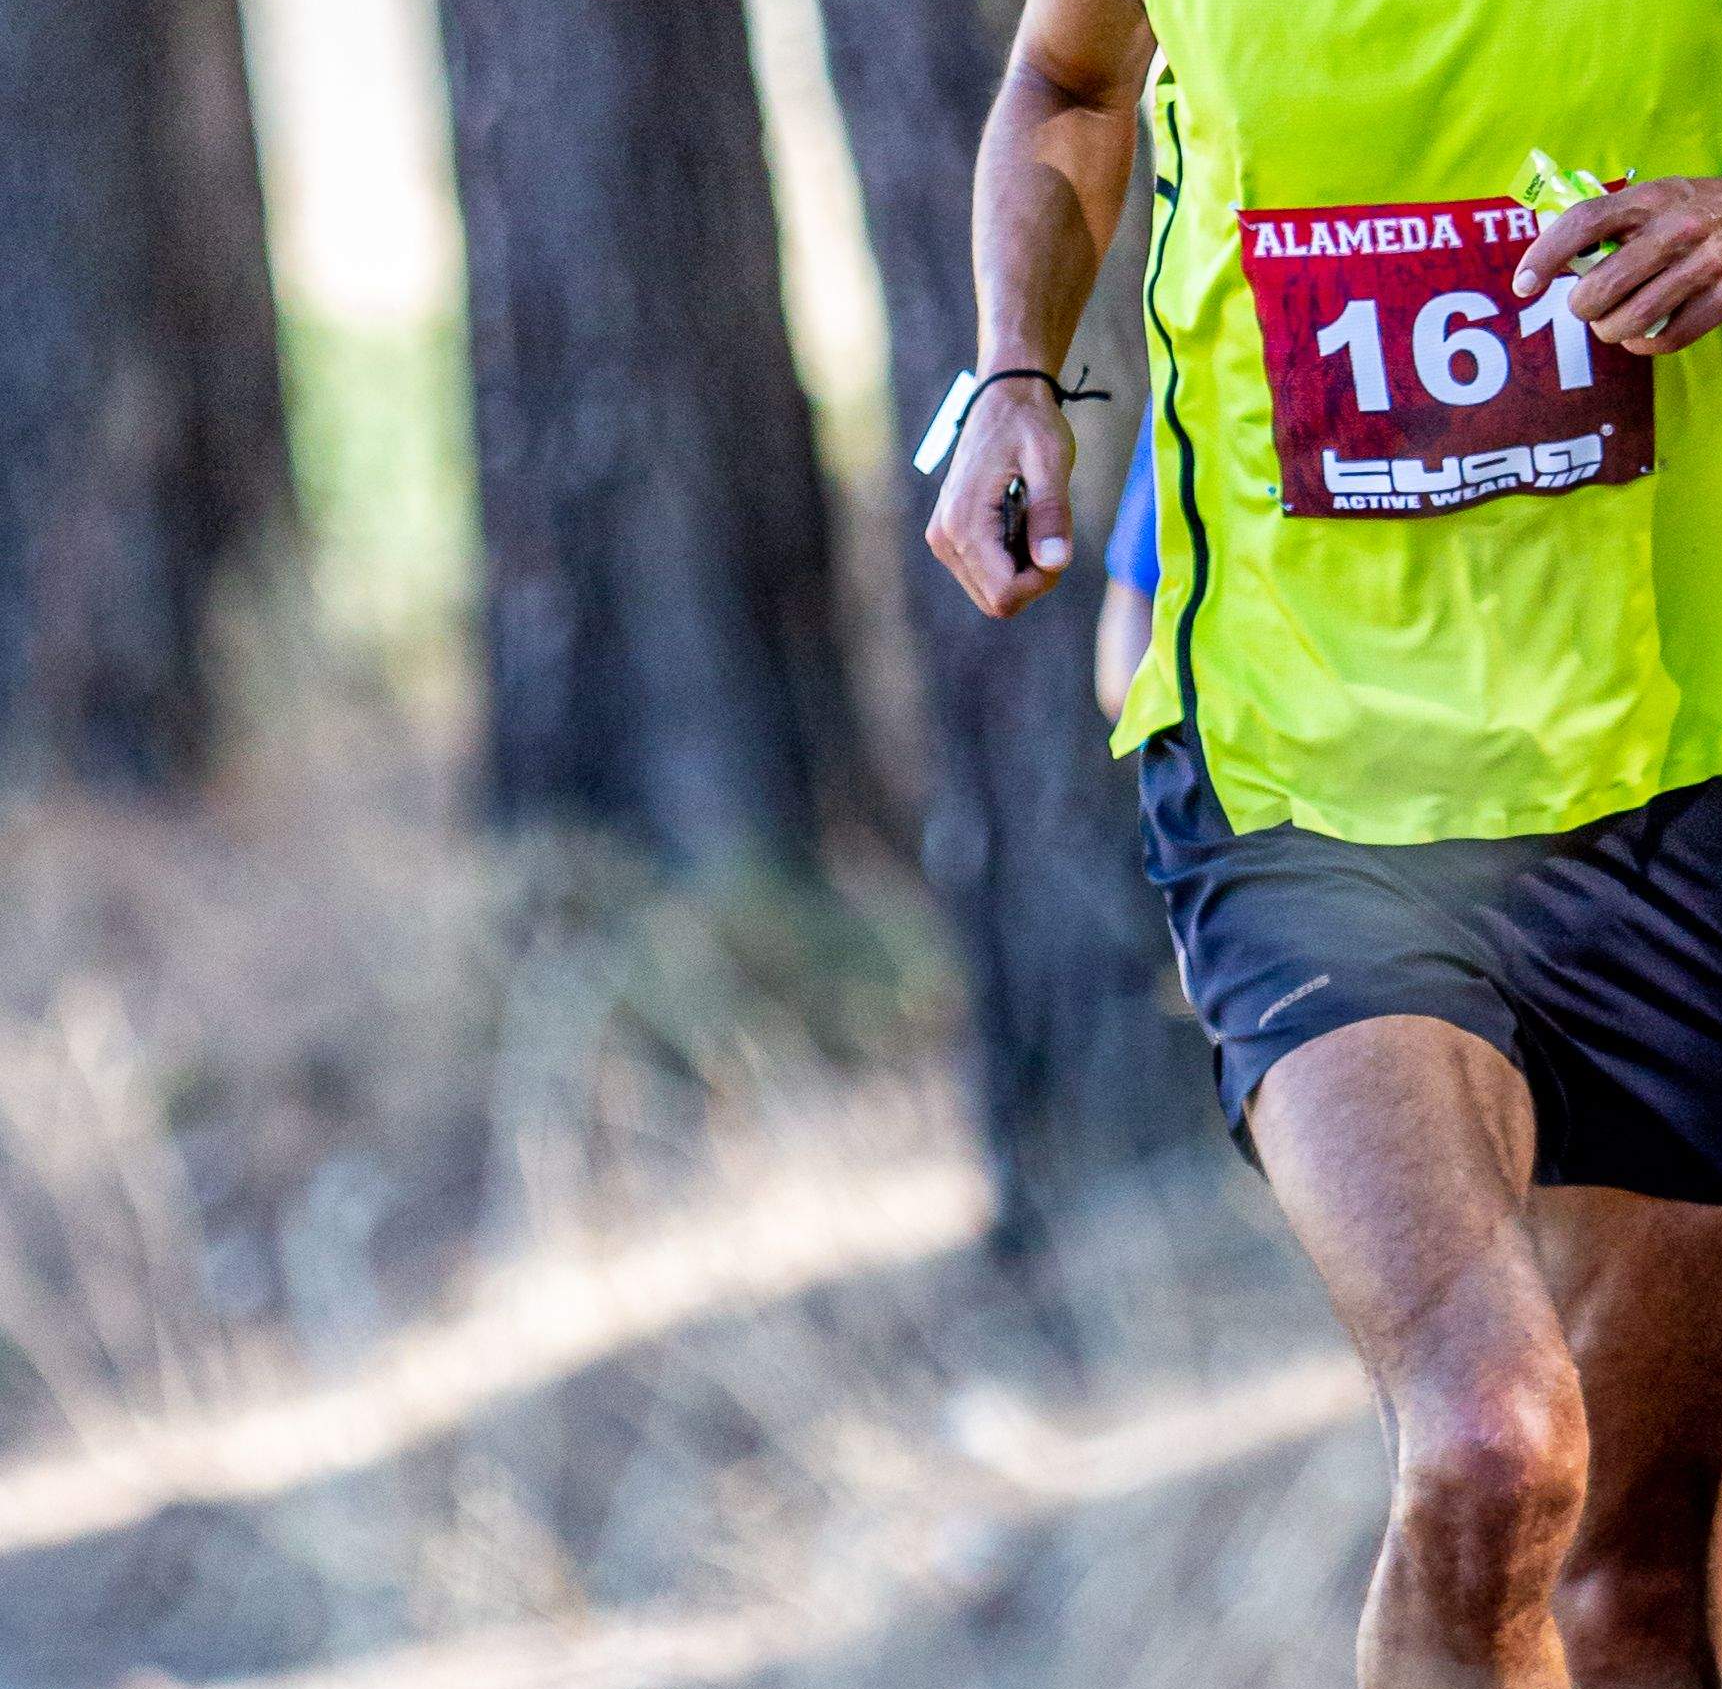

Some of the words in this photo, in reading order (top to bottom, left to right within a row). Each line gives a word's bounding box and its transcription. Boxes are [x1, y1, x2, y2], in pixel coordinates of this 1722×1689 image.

[1253, 213, 1463, 258] ALAMEDA
[1316, 274, 1594, 412] 161
[1332, 494, 1422, 510] ACTIVE
[1429, 476, 1519, 507] WEAR
